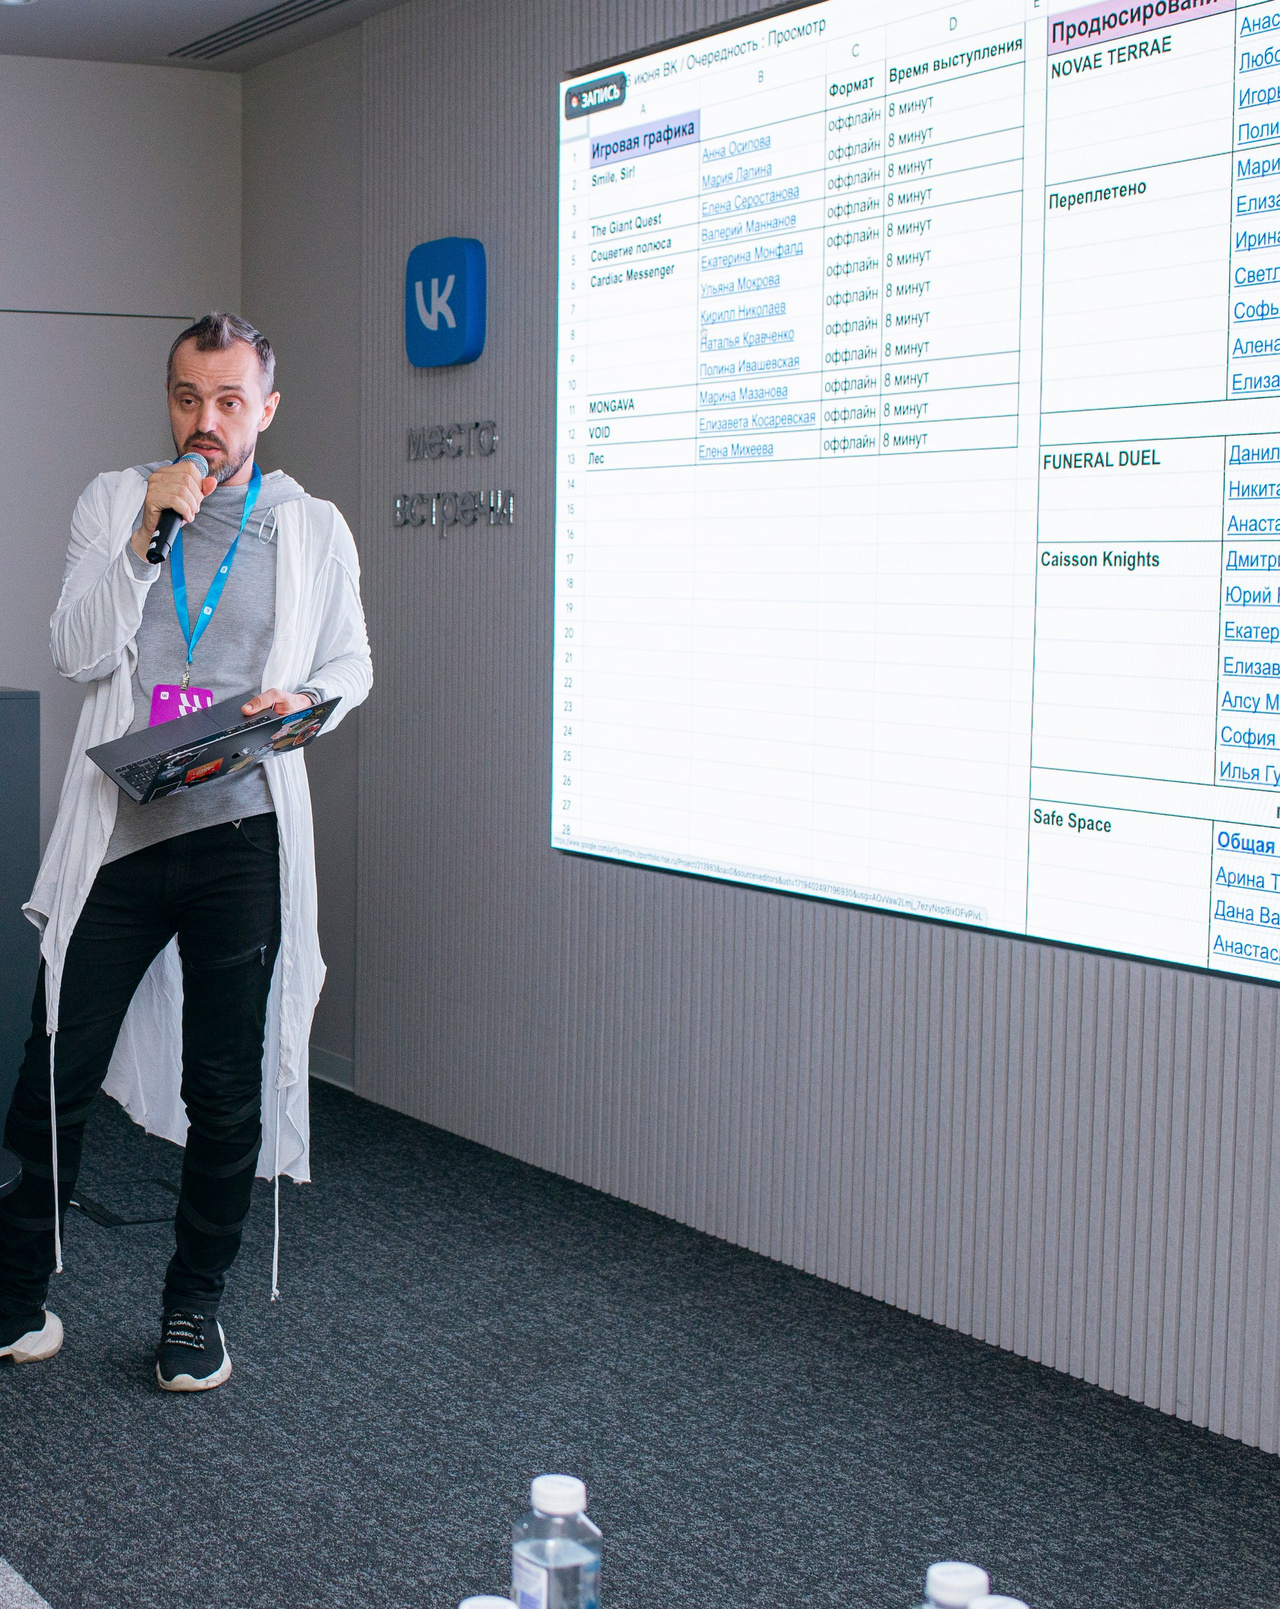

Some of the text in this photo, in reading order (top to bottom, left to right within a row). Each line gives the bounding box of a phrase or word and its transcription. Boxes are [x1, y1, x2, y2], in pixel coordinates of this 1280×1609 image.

[949, 17, 958, 31] D
[1051, 0, 1220, 45] Продюсирова
[1240, 13, 1280, 35] Анас
[634, 67, 660, 86] июня
[663, 59, 678, 77] ВК
[686, 40, 759, 71] Очередность
[768, 17, 826, 47] Просмотр
[889, 38, 1023, 84] Время выступления
[1051, 35, 1172, 79] NOVAE TERRAE
[581, 83, 621, 109] ЗАПИСЬ
[829, 77, 875, 97] Формат
[1239, 86, 1280, 108] Игор
[888, 96, 934, 117] 8 минут
[828, 107, 881, 132] оффлайн
[591, 121, 695, 161] Игровая графика
[702, 134, 772, 161] Анна Осипова
[888, 127, 933, 147] 8 минут
[828, 137, 881, 162] оффлайн
[591, 165, 636, 187] Smile, Sir!
[702, 163, 773, 190] Мария Лапина
[887, 158, 933, 178] 8 минут
[828, 167, 880, 192] оффлайн
[701, 185, 800, 216] Елена Серостанова
[887, 188, 933, 207] 8 минут
[1049, 181, 1147, 210] Переплетено
[827, 197, 880, 220] оффлайн
[591, 213, 662, 238] The Giant Quest
[701, 215, 797, 243] Валерий Маннанов
[887, 219, 932, 237] 8 минут
[827, 226, 879, 249] оффлайн
[590, 238, 672, 264] Соцветие полюса
[701, 241, 804, 270] Екатерина Монфалд
[886, 250, 931, 268] 8 минут
[590, 264, 676, 288] Cardiac Messenger
[826, 256, 879, 279] оффлайн
[701, 273, 781, 298] Ульяна Мокрова
[885, 281, 931, 298] 8 минут
[415, 274, 457, 331] VK
[826, 286, 878, 308] оффлайн
[700, 301, 787, 325] Кирилл Николаев
[885, 311, 930, 328] 8 минут
[1234, 300, 1280, 320] Софь
[825, 316, 878, 338] оффлайн
[700, 328, 795, 350] Наталья Кравченко
[885, 341, 930, 358] 8 минут
[700, 355, 800, 377] Полина Ивашевская
[825, 345, 877, 366] оффлайн
[825, 375, 877, 396] оффлайн
[884, 372, 929, 389] 8 минут
[588, 398, 635, 414] MONGAVA
[699, 384, 788, 406] Марина Мазанова
[699, 410, 816, 432] Елизавета Косаревская
[824, 405, 876, 424] оффлайн
[883, 402, 928, 419] 8 минут
[407, 421, 499, 461] место
[588, 426, 611, 440] VOID
[883, 433, 928, 450] 8 минут
[698, 442, 774, 459] Елена Михеева
[823, 435, 876, 454] оффлайн
[587, 452, 605, 466] Лес
[1043, 449, 1161, 470] FUNERAL DUEL
[393, 490, 515, 539] встречи
[1041, 550, 1160, 571] Caisson Knights
[1226, 550, 1280, 571] Дмитр
[1225, 585, 1271, 606] Юрий
[564, 627, 574, 639] 20
[1224, 621, 1280, 643] Екатер
[565, 652, 573, 663] 21
[564, 676, 573, 688] 22
[563, 701, 573, 712] 23
[1221, 690, 1261, 713] Алсу
[563, 725, 572, 737] 24
[1220, 725, 1276, 748] София
[563, 750, 572, 761] 25
[562, 775, 571, 786] 26
[1220, 760, 1260, 781] Илья
[562, 799, 571, 810] 27
[1033, 808, 1112, 833] Safe Space
[1217, 831, 1275, 854] Общая
[1216, 866, 1264, 889] Арина
[1214, 899, 1254, 921] Дана
[1213, 934, 1280, 963] Анастас
